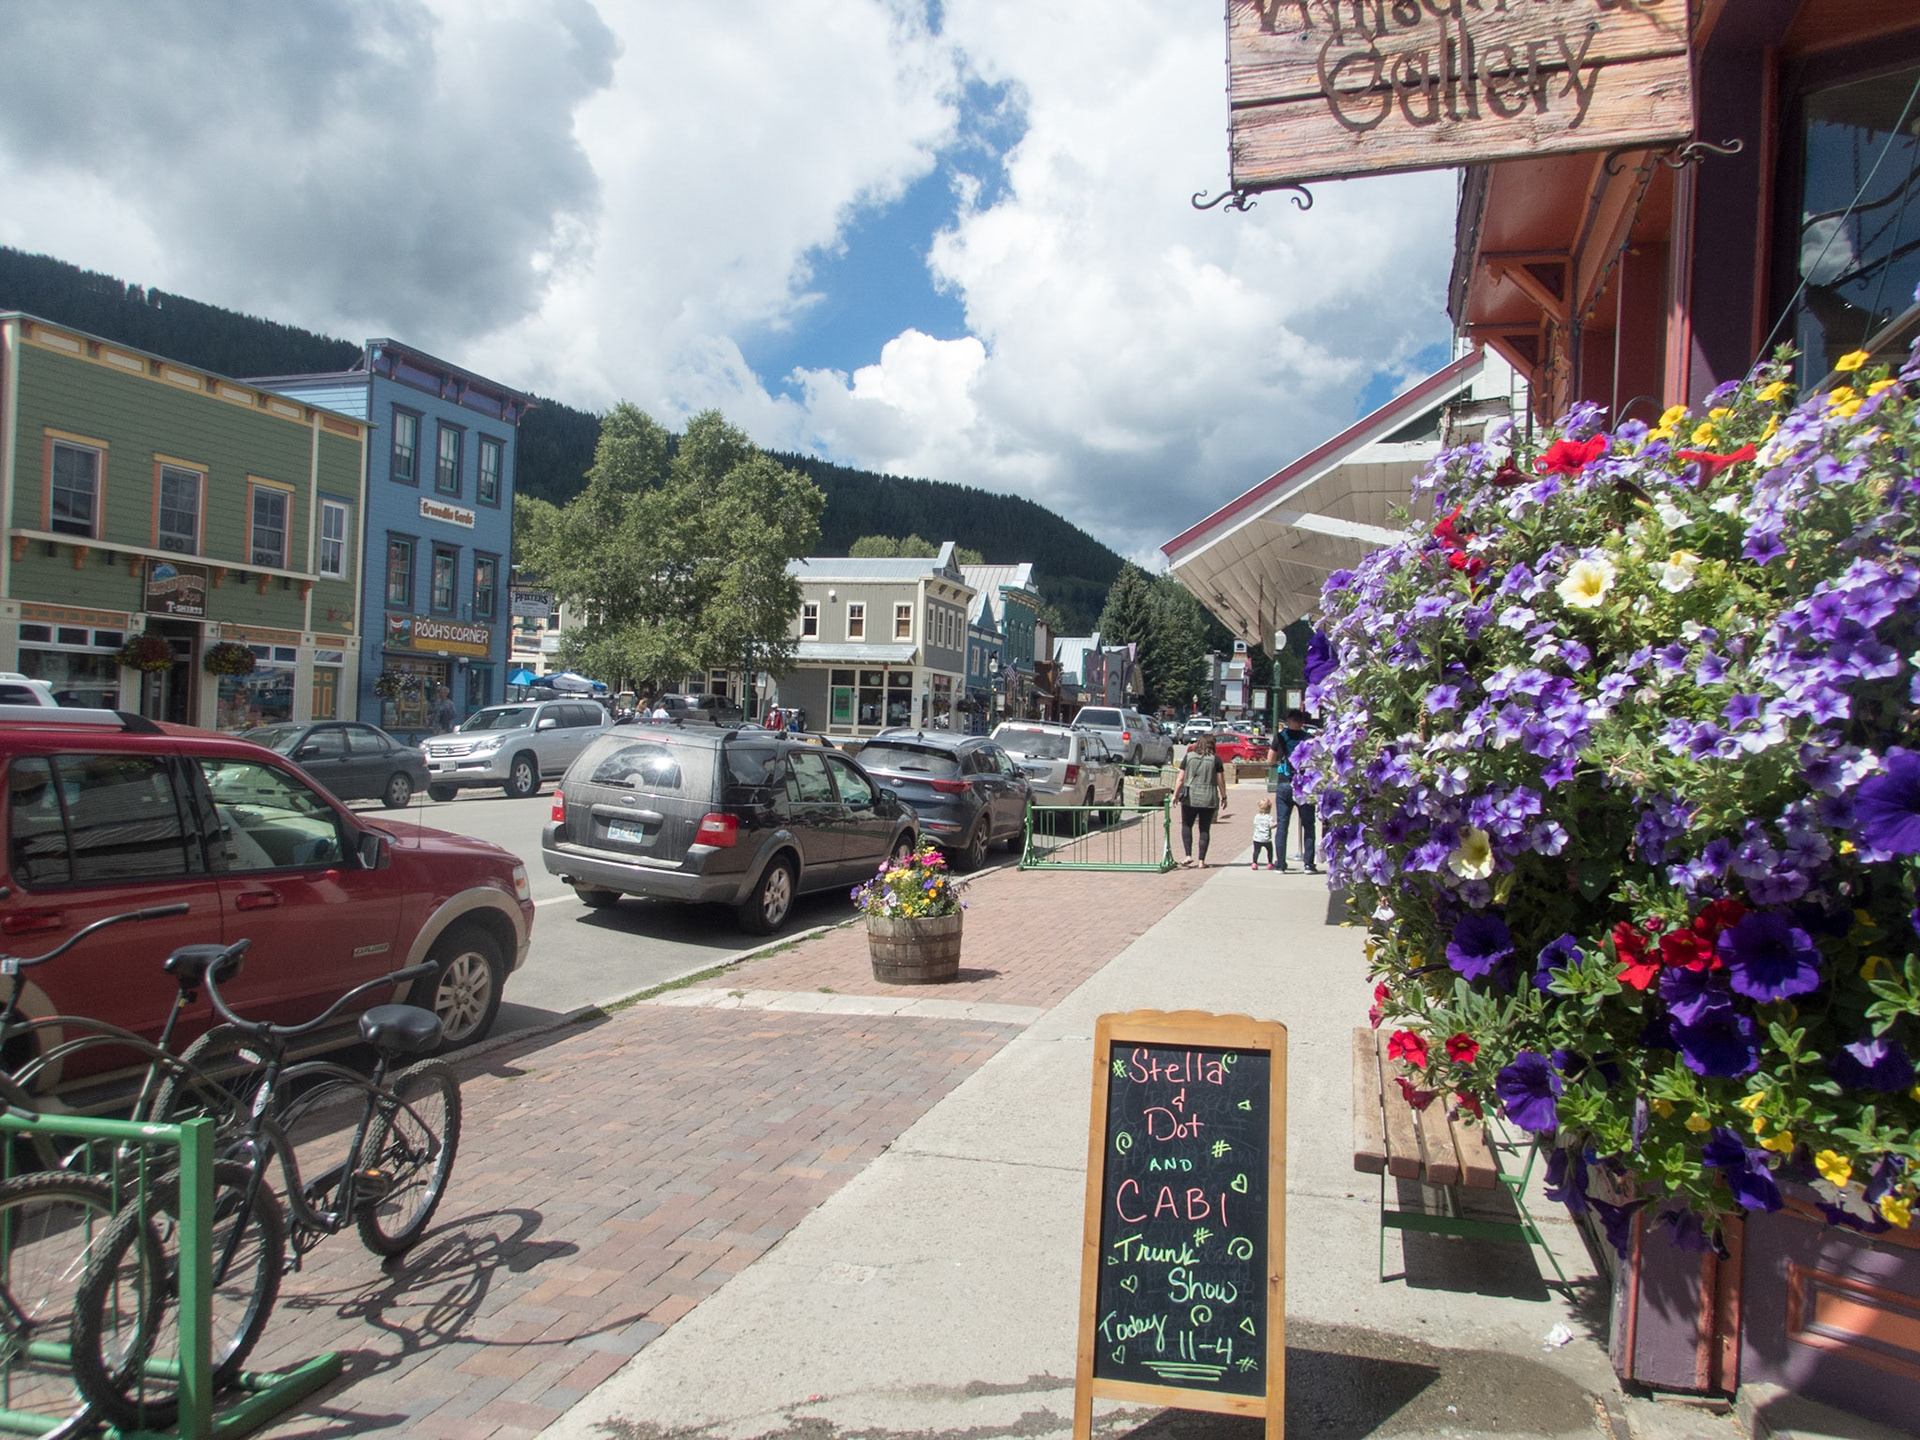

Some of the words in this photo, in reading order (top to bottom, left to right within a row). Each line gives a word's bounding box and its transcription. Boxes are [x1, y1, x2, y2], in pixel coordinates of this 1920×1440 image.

[1317, 17, 1597, 104] Gallery
[414, 621, 450, 639] POOH'S
[450, 626, 489, 644] CORNER
[1129, 1047, 1223, 1085] Stella
[1143, 1106, 1205, 1141] Dot
[1149, 1157, 1194, 1173] AND
[1116, 1178, 1228, 1227] CABI
[1113, 1233, 1200, 1266] Trunk
[1167, 1267, 1238, 1304] Show
[1098, 1310, 1169, 1352] Today
[1178, 1330, 1233, 1365] 11-4
